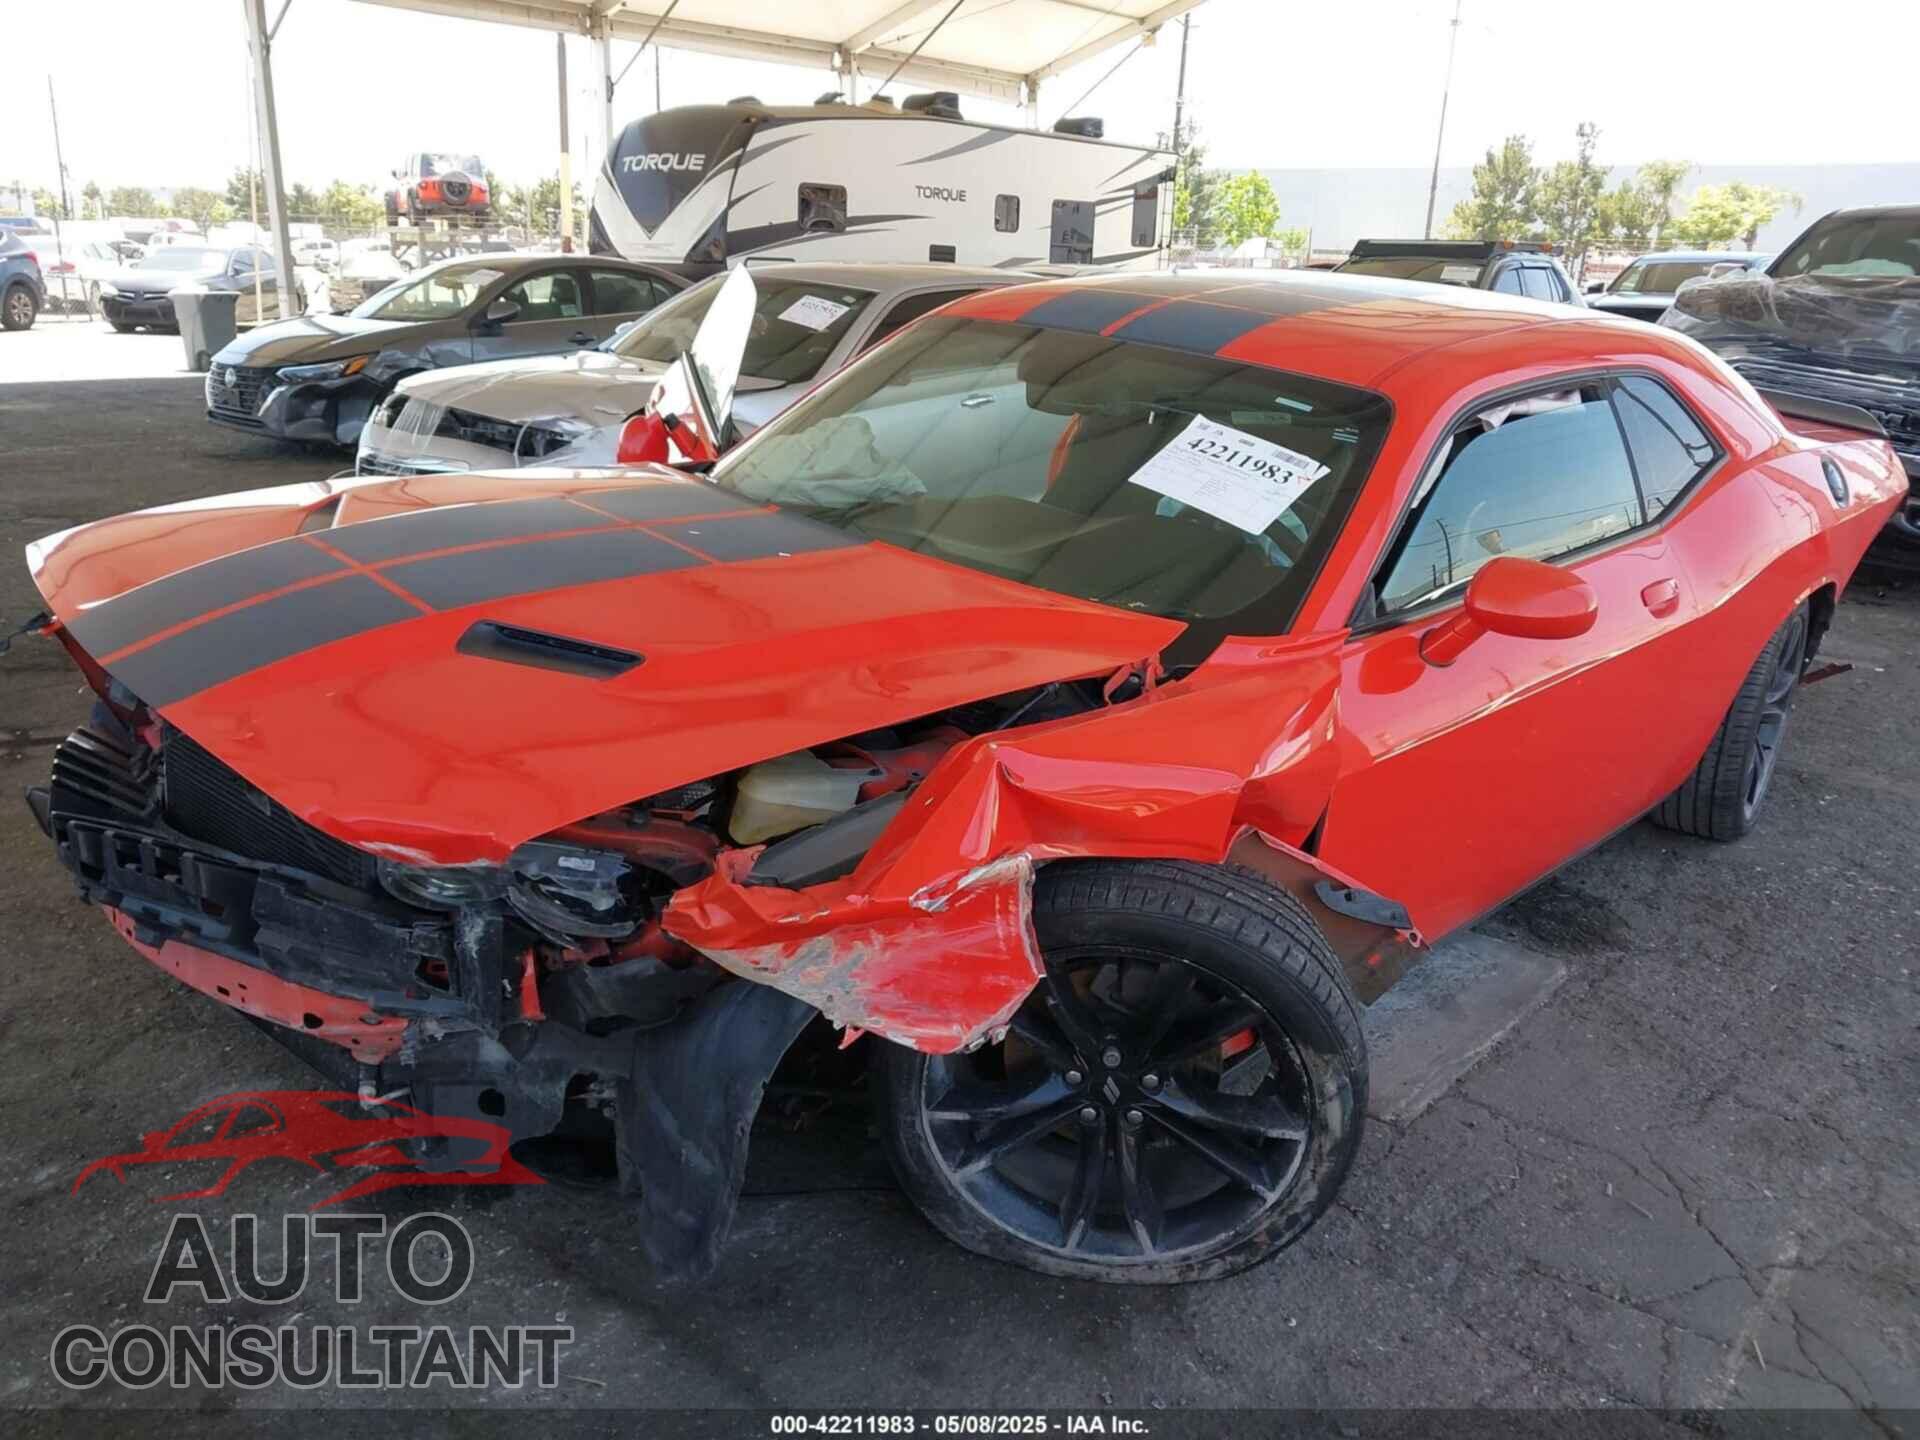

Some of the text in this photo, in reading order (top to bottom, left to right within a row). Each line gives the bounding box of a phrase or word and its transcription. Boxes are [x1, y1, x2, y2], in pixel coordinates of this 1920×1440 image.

[623, 153, 706, 173] TORQUE
[915, 185, 967, 202] TORQUE
[1187, 438, 1293, 484] 42211983
